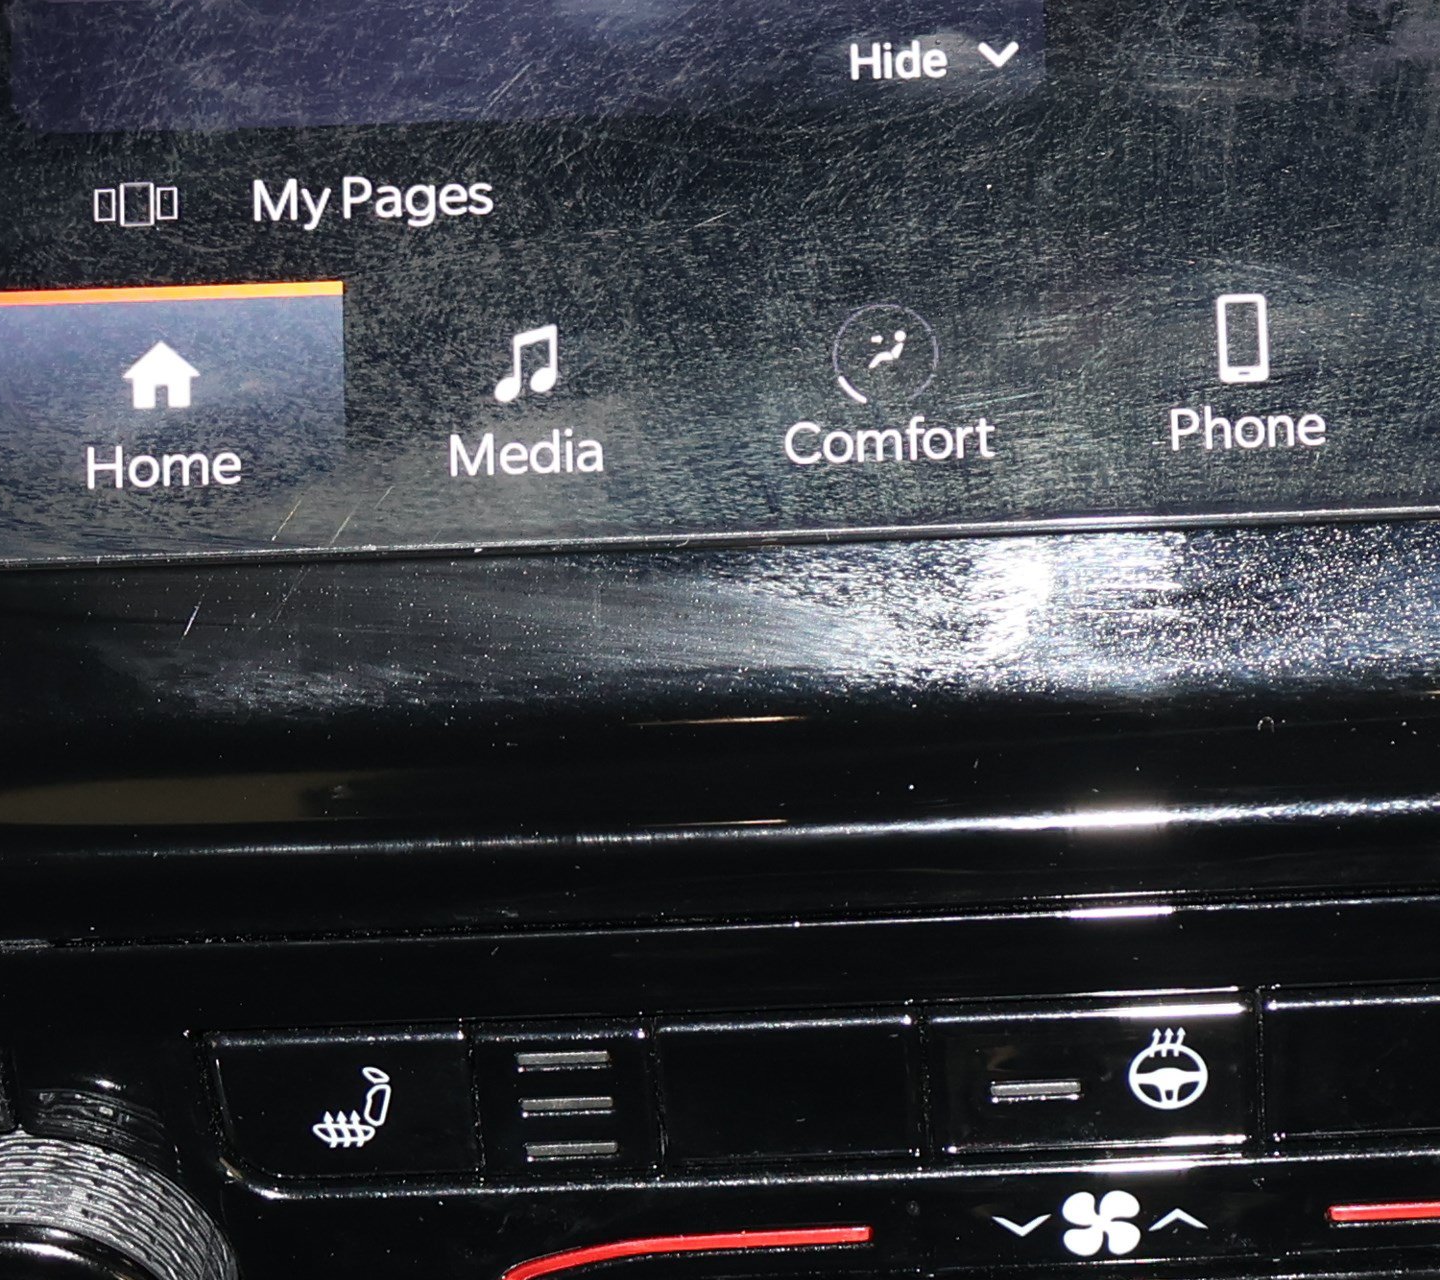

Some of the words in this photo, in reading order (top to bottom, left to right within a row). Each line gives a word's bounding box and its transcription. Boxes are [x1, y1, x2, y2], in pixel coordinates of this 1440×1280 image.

[850, 39, 948, 81] Hide
[253, 178, 332, 231] My
[342, 176, 494, 228] Pages
[450, 428, 604, 477] Media
[784, 415, 999, 465] Comfort
[1170, 405, 1326, 452] Phone
[86, 445, 242, 490] Home
